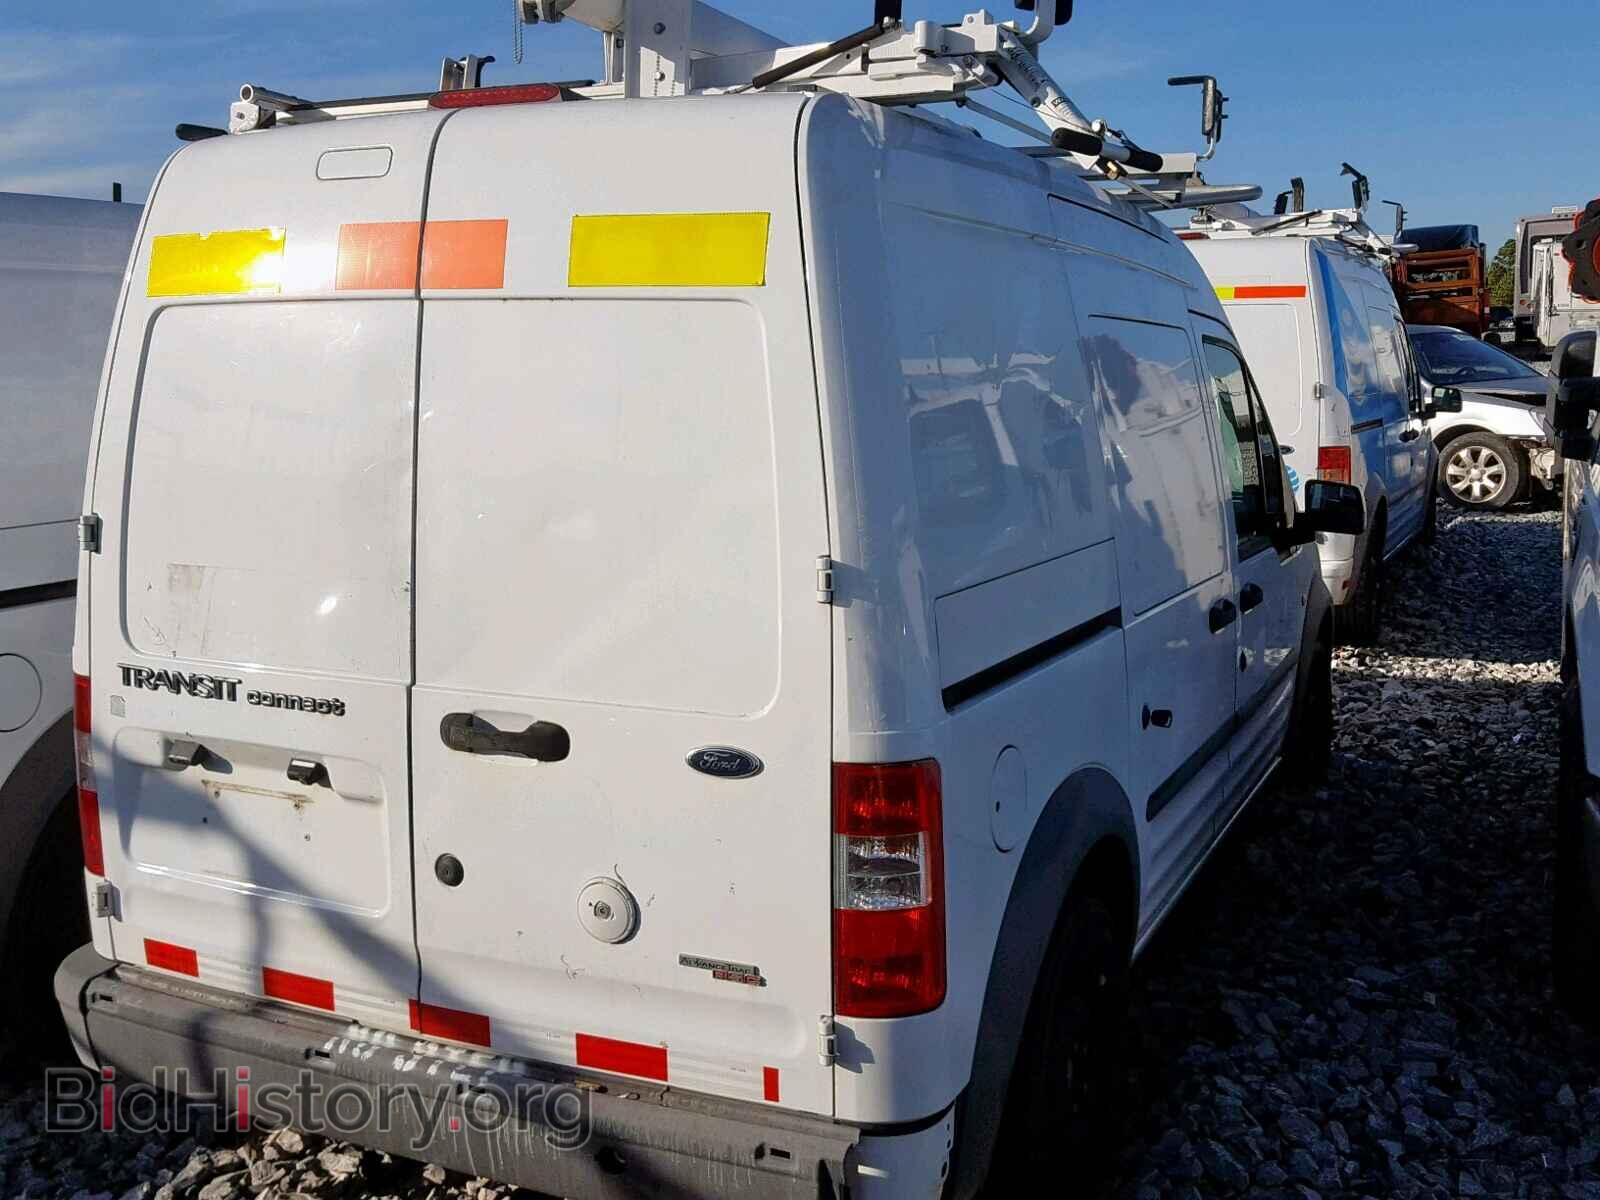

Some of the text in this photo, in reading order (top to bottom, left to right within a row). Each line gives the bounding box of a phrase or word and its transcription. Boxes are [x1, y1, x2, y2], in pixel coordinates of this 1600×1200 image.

[117, 663, 346, 717] TRANSIT connect
[700, 752, 741, 770] Ford
